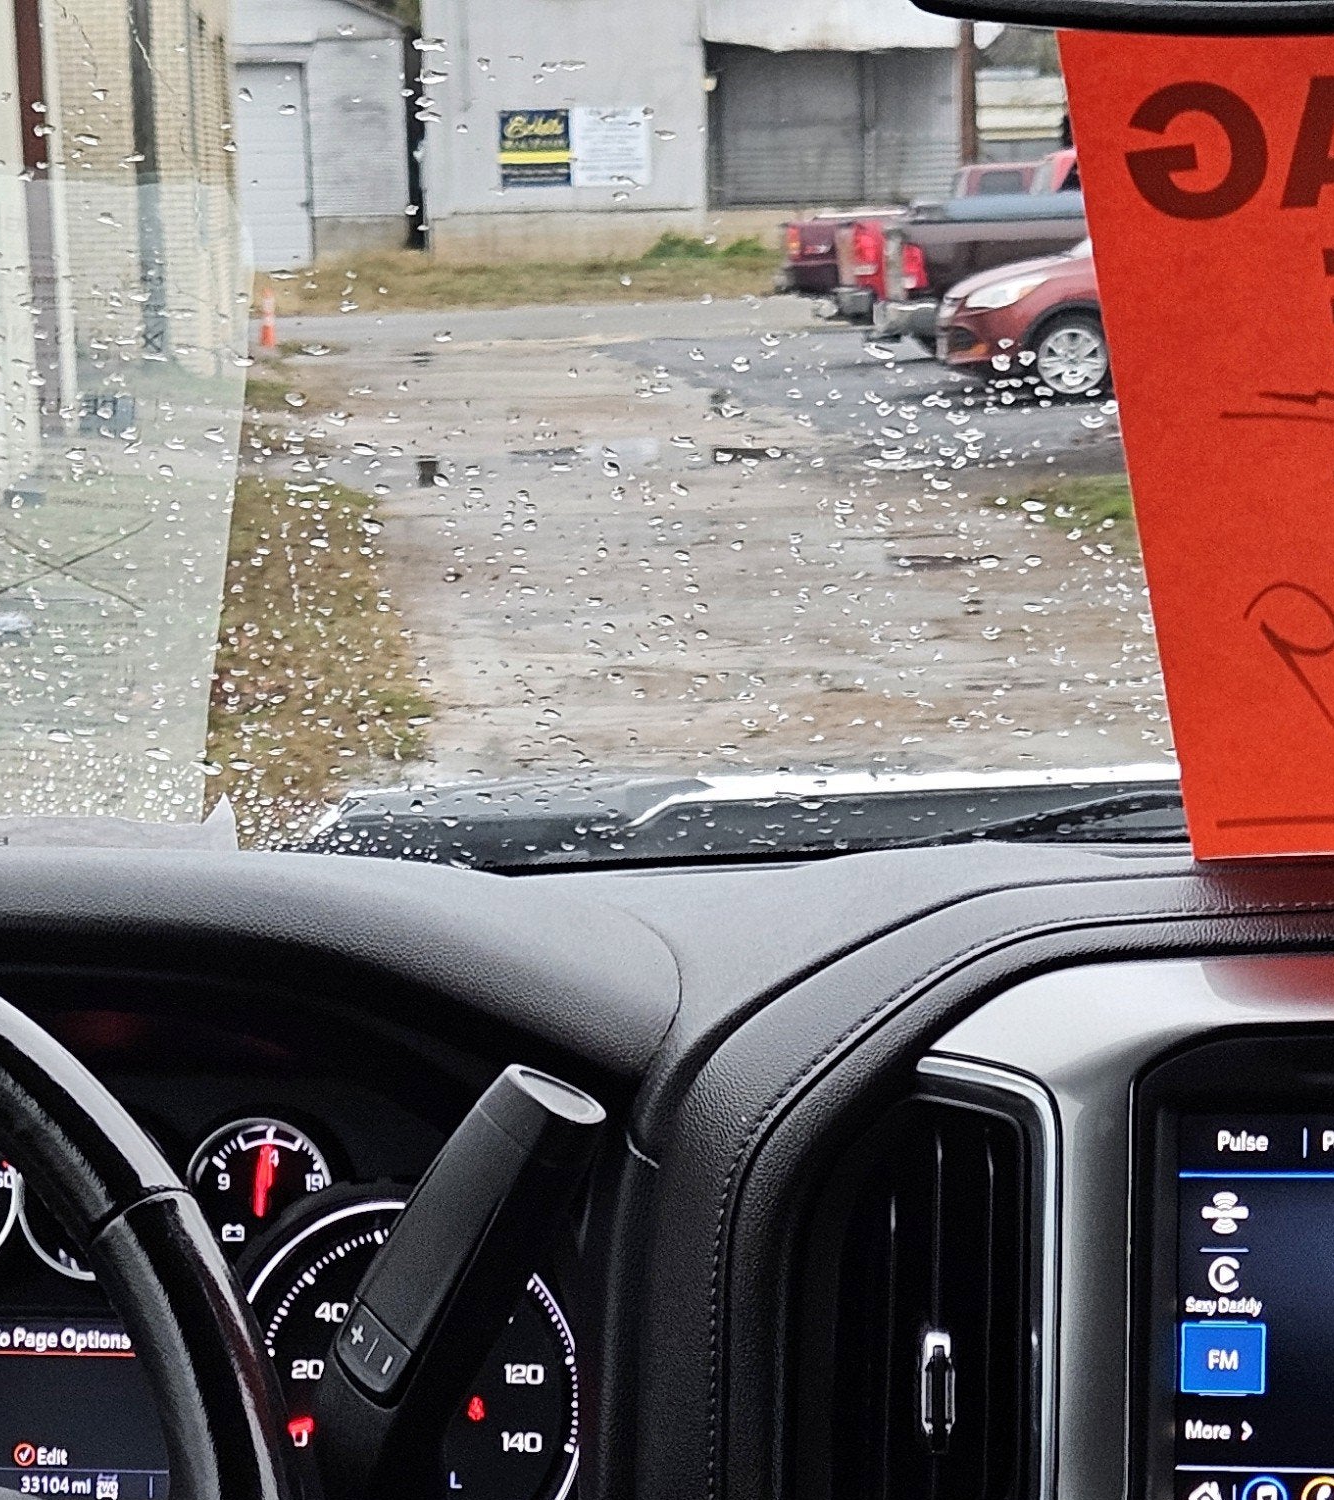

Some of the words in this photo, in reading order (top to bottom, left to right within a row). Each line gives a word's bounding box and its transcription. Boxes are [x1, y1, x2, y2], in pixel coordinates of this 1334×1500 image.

[1217, 1130, 1269, 1152] Pulse
[217, 1172, 231, 1190] 9
[305, 1173, 324, 1192] 19
[315, 1302, 348, 1322] 40
[1186, 1296, 1216, 1316] Sexy
[1218, 1296, 1263, 1317] Daddy
[13, 1327, 58, 1352] Page
[60, 1328, 132, 1354] Options
[290, 1359, 325, 1380] 20
[1208, 1349, 1239, 1370] FM
[504, 1363, 545, 1385] 120
[1185, 1419, 1231, 1440] More
[501, 1432, 543, 1454] 140
[37, 1446, 67, 1466] Edit
[20, 1475, 69, 1494] 33104
